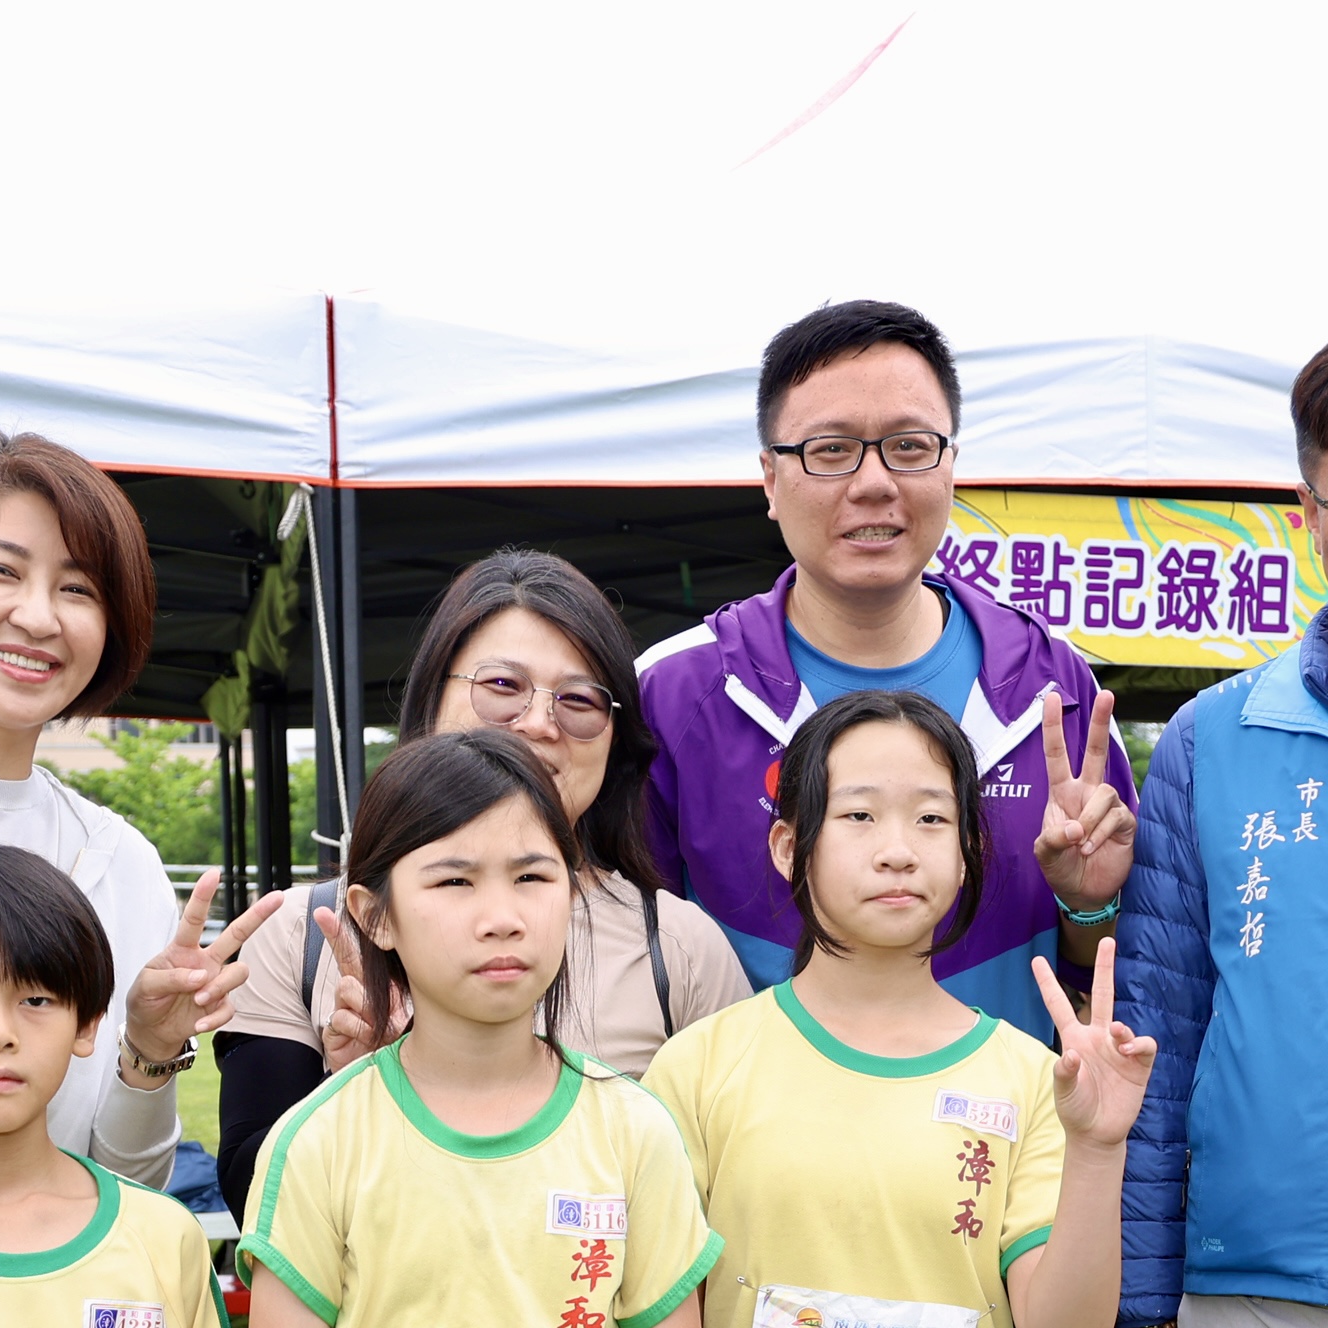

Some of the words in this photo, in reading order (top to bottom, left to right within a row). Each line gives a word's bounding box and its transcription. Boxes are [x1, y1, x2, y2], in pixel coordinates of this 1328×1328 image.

[936, 535, 1290, 635] 終點記錄組
[980, 783, 1032, 798] JETLIT
[1292, 778, 1323, 842] 市長
[1237, 811, 1285, 958] 張嘉哲
[969, 1108, 1011, 1130] 5210
[583, 1211, 625, 1230] 5116
[951, 1139, 996, 1246] 漳和
